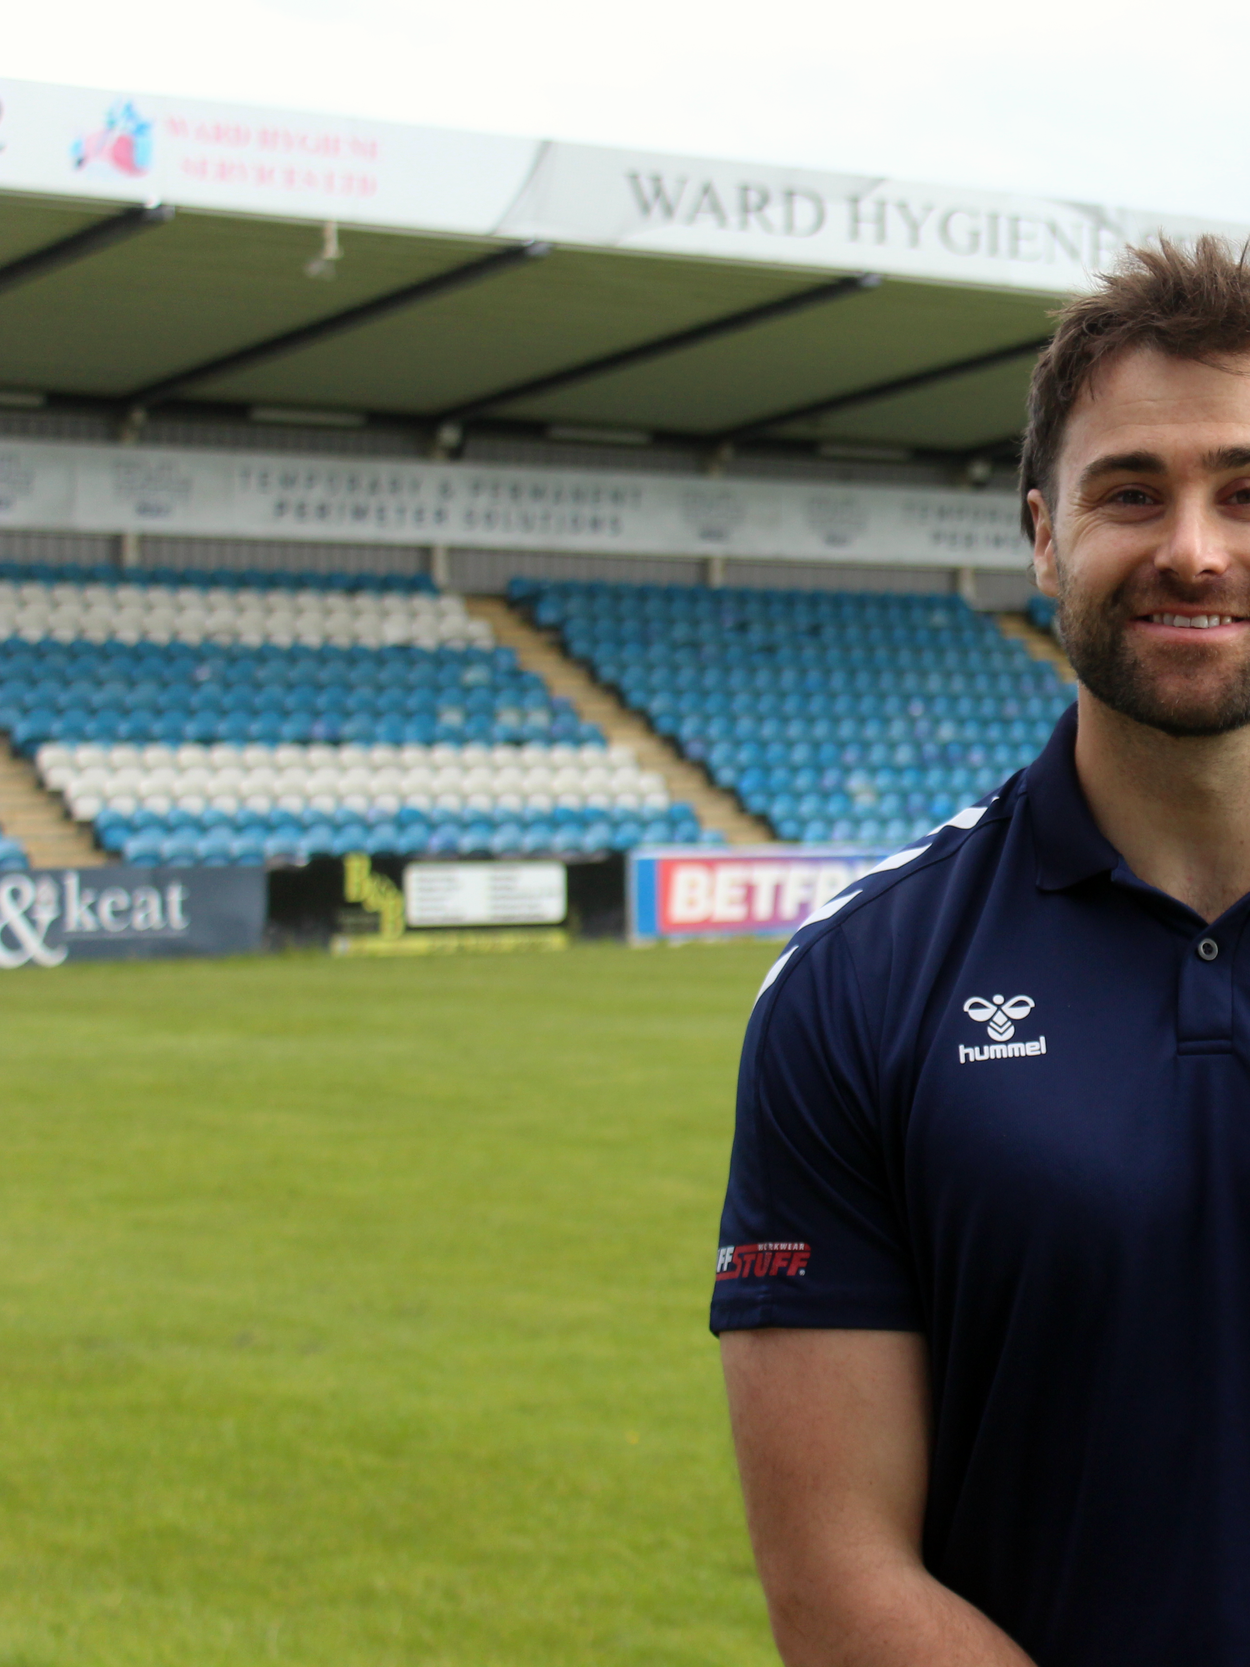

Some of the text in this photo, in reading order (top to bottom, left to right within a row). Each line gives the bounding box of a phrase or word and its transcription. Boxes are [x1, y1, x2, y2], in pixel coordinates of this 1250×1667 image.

[626, 168, 827, 240] WARD
[272, 500, 624, 537] PERIMETER SOLUTIONS
[63, 871, 190, 933] keat
[668, 862, 872, 925] BETFR
[959, 1035, 1047, 1064] hummel
